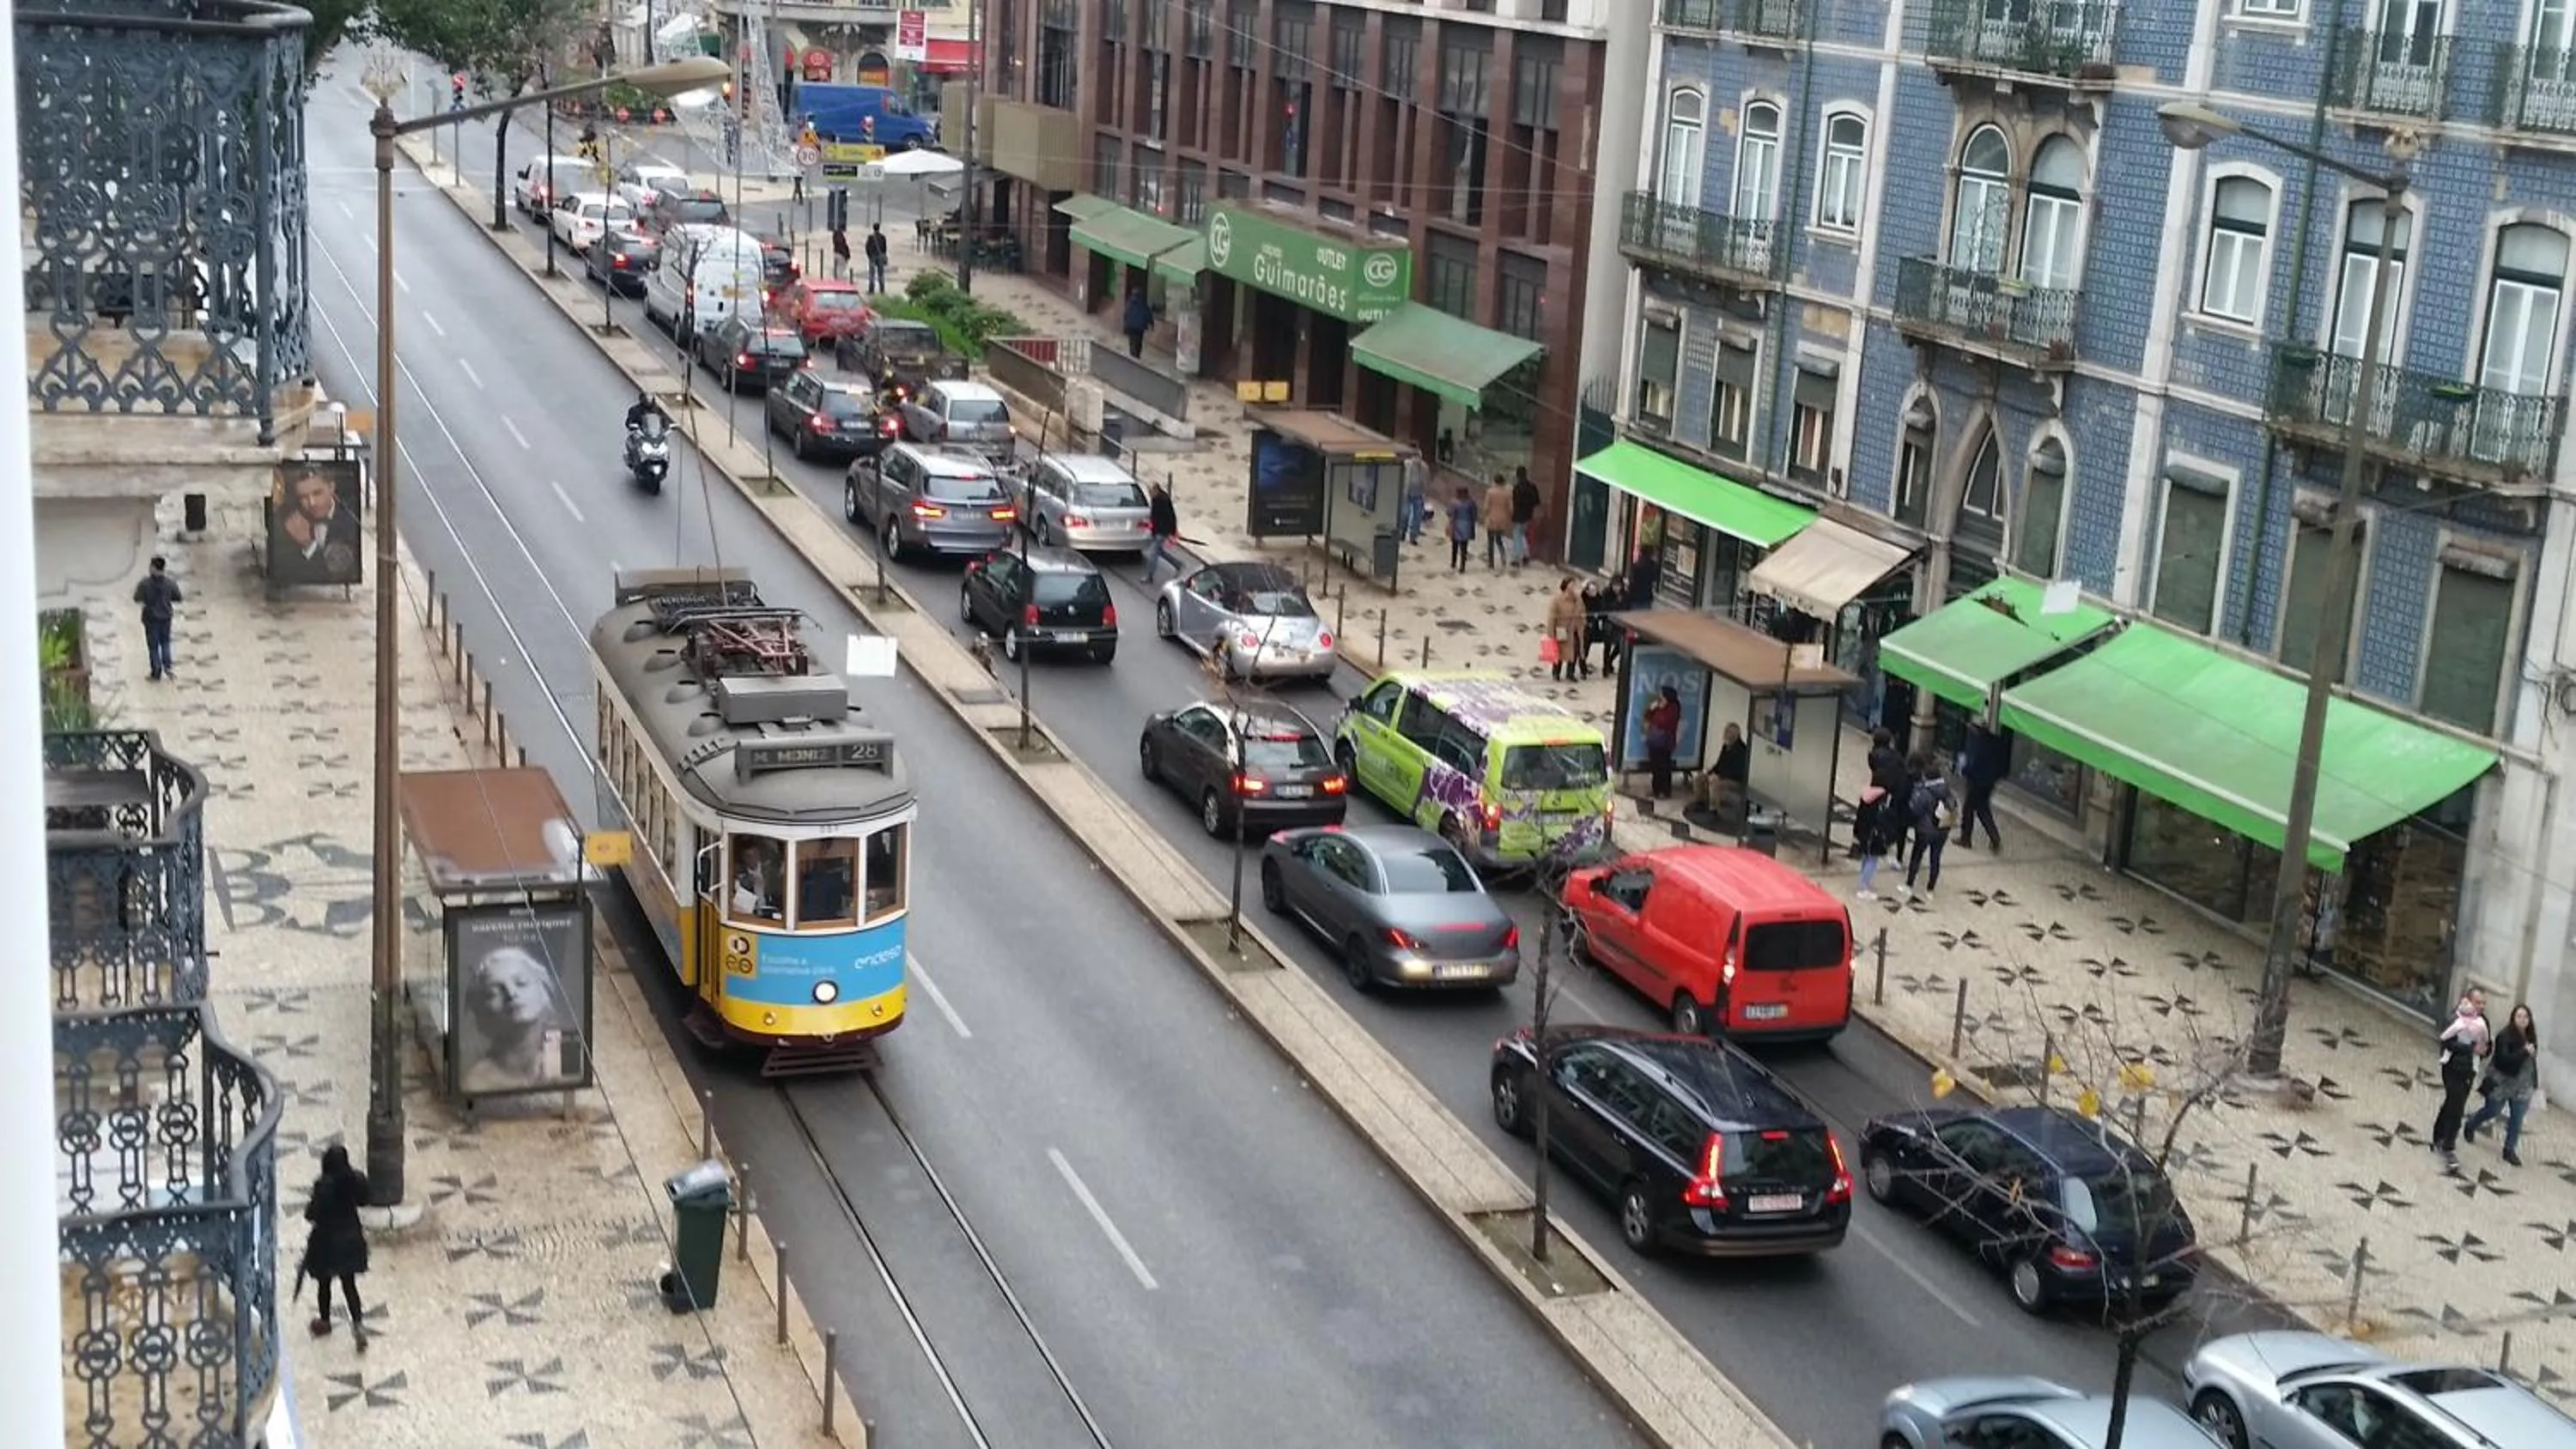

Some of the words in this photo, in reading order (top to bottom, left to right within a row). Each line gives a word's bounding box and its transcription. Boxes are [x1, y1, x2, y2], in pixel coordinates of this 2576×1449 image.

[1315, 246, 1347, 271] OUTLET
[1254, 253, 1346, 312] Guimarães
[1637, 670, 1699, 694] NOS
[851, 743, 878, 760] 28
